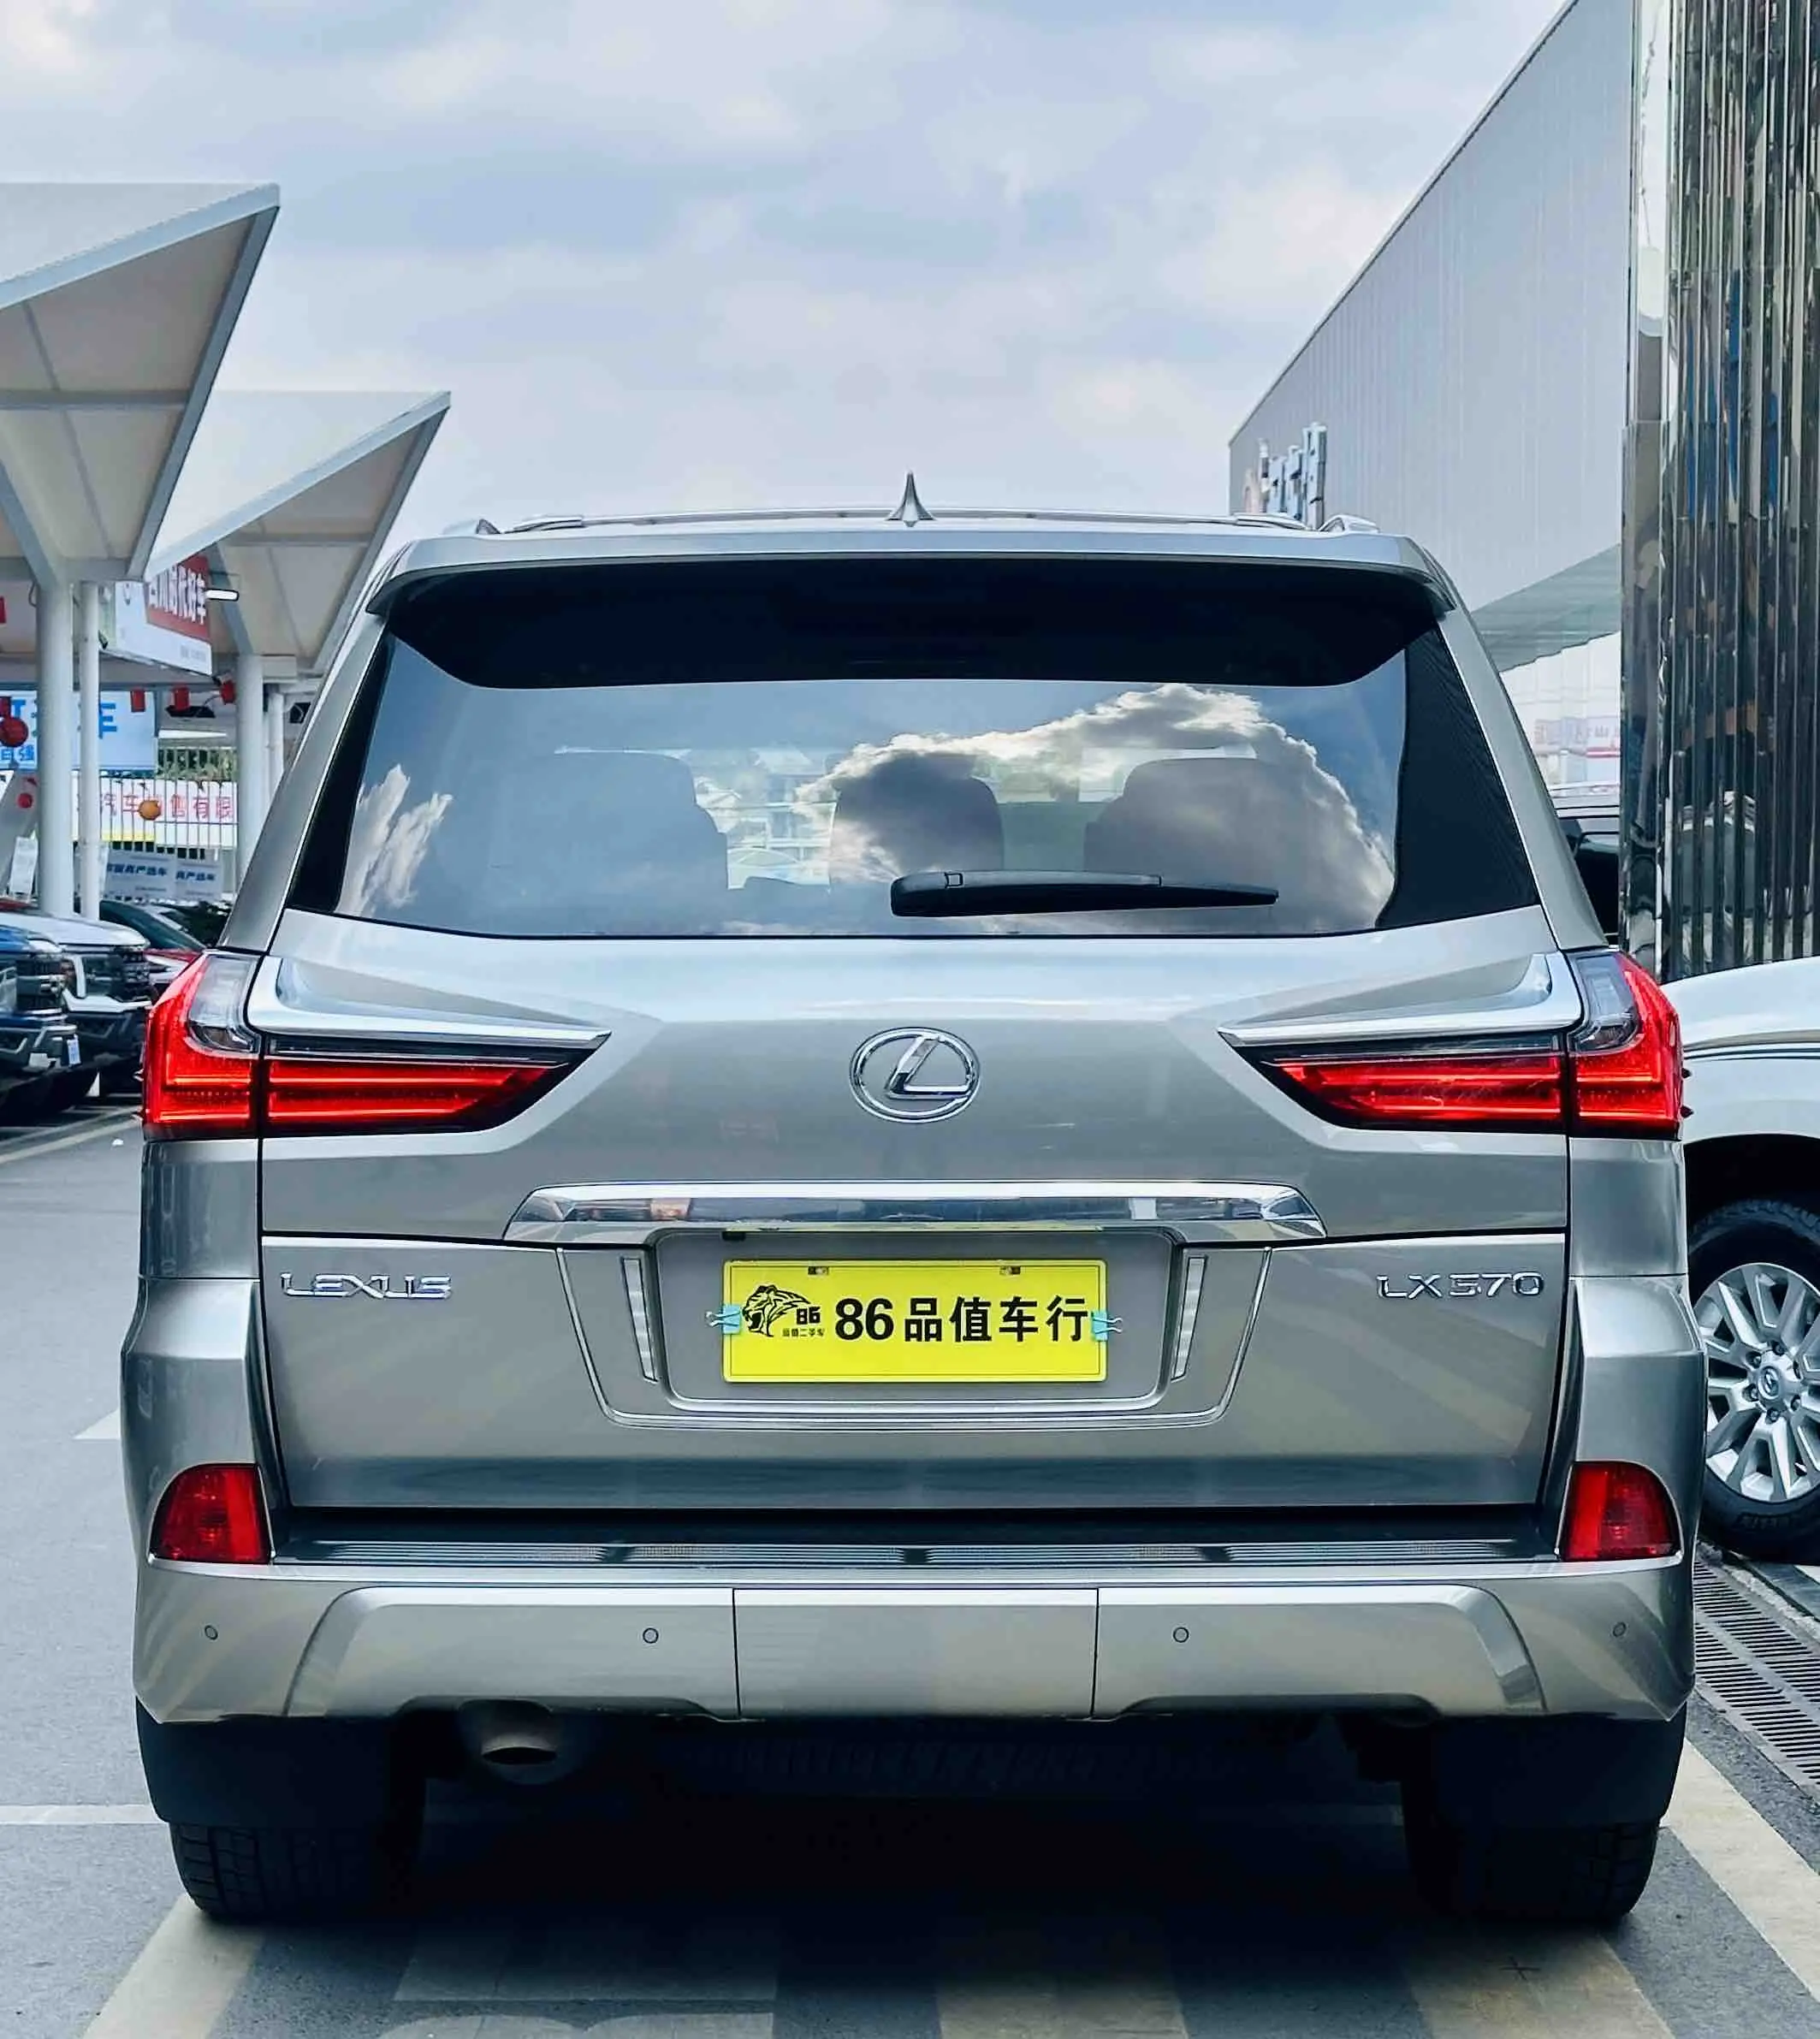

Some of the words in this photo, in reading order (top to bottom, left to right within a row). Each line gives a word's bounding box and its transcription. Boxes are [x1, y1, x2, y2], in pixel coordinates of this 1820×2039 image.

[101, 793, 234, 821] 汽车售有限
[280, 1271, 452, 1300] LEXUS
[796, 1306, 821, 1325] 86
[834, 1295, 1088, 1343] 86品值车行
